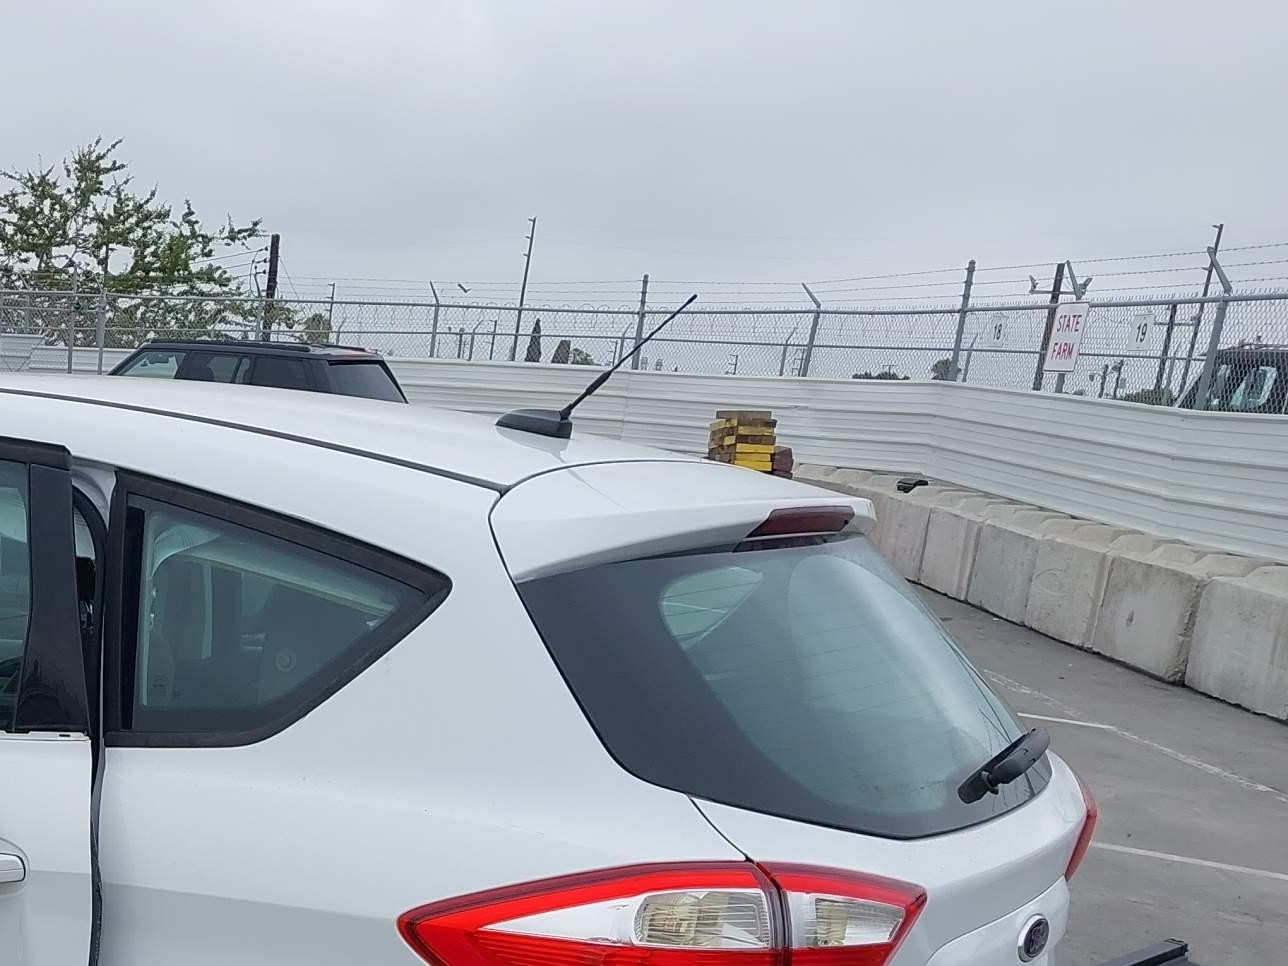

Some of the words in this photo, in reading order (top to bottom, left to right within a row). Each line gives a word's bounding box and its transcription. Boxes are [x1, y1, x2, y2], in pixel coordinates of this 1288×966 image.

[993, 323, 1003, 340] 18
[1057, 315, 1082, 332] STATE
[1136, 323, 1148, 342] 19
[1051, 342, 1075, 360] FARM
